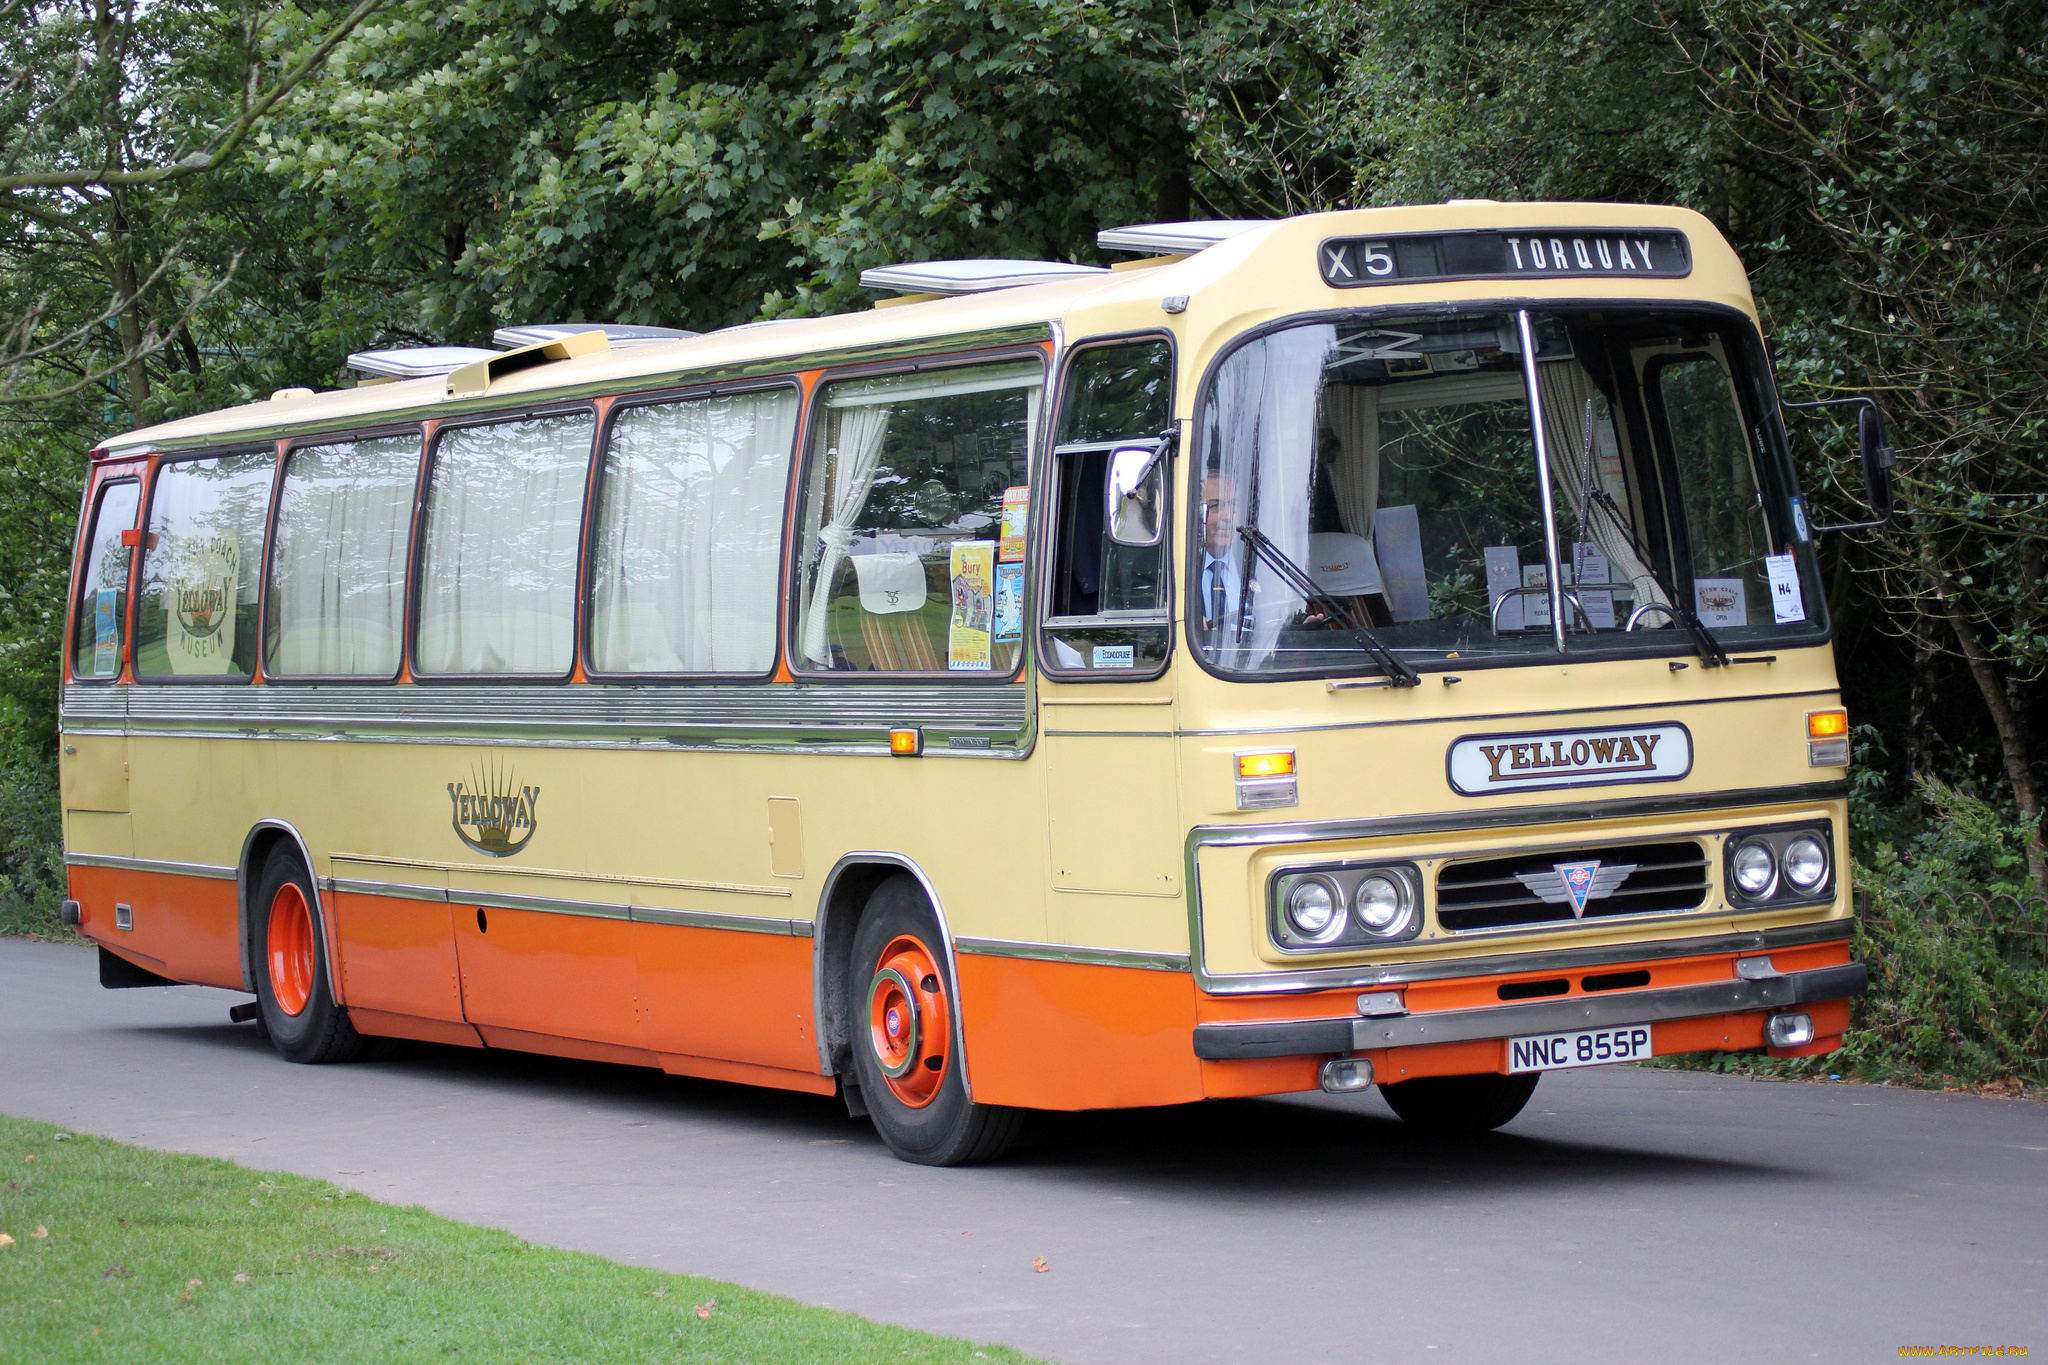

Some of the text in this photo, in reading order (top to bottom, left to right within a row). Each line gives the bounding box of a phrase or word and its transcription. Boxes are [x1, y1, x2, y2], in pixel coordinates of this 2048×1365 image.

[1507, 237, 1654, 271] TORQUAY
[210, 537, 238, 574] COACH
[962, 561, 981, 576] Bury
[176, 577, 232, 614] YELLOWAY
[1720, 587, 1739, 596] COACH
[1778, 583, 1791, 596] H4
[180, 628, 223, 658] MUSEUM
[1479, 734, 1661, 782] YELLOWAY
[446, 783, 541, 832] YELLOWAY
[1571, 872, 1589, 881] AEC
[1513, 1029, 1648, 1069] NNC 855P
